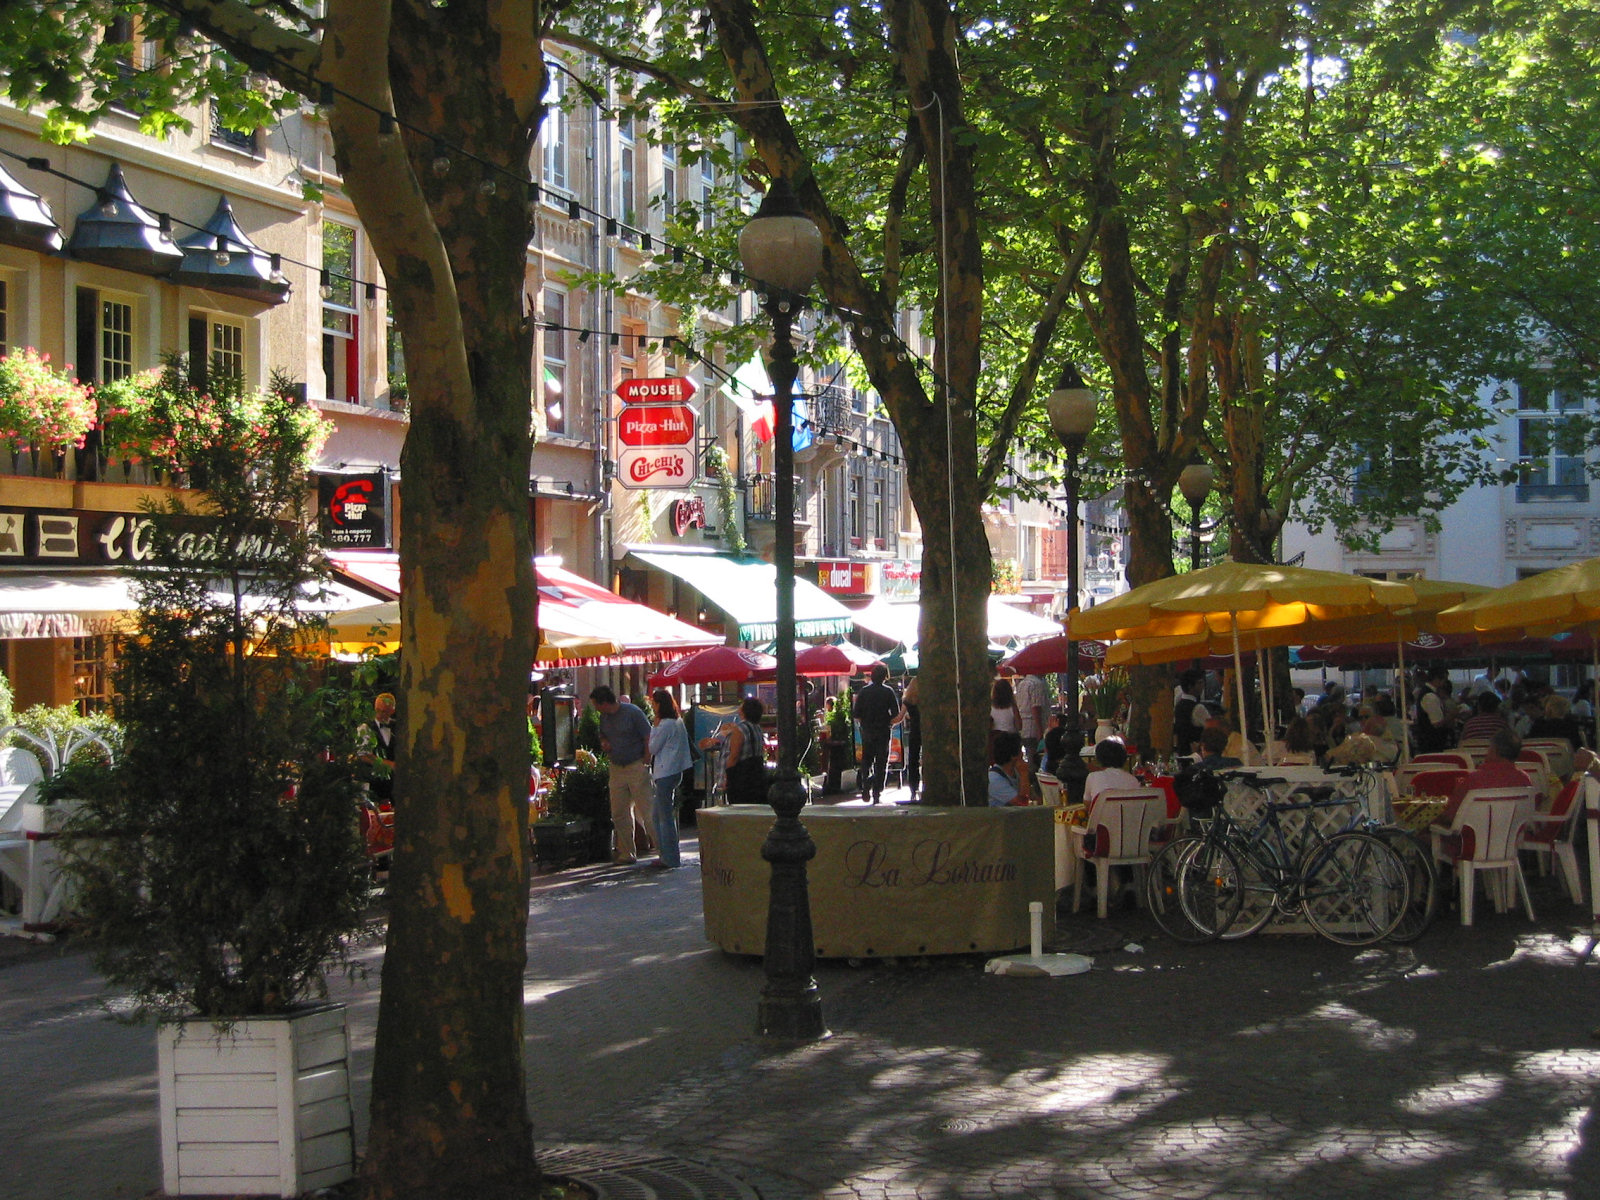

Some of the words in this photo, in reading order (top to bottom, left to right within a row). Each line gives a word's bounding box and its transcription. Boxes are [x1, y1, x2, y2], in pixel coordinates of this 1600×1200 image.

[628, 384, 683, 396] MOUSEL
[626, 420, 658, 434] Pizza
[659, 418, 685, 432] Hut
[344, 502, 368, 513] Pizza
[830, 562, 852, 588] ducal
[843, 840, 902, 889] La
